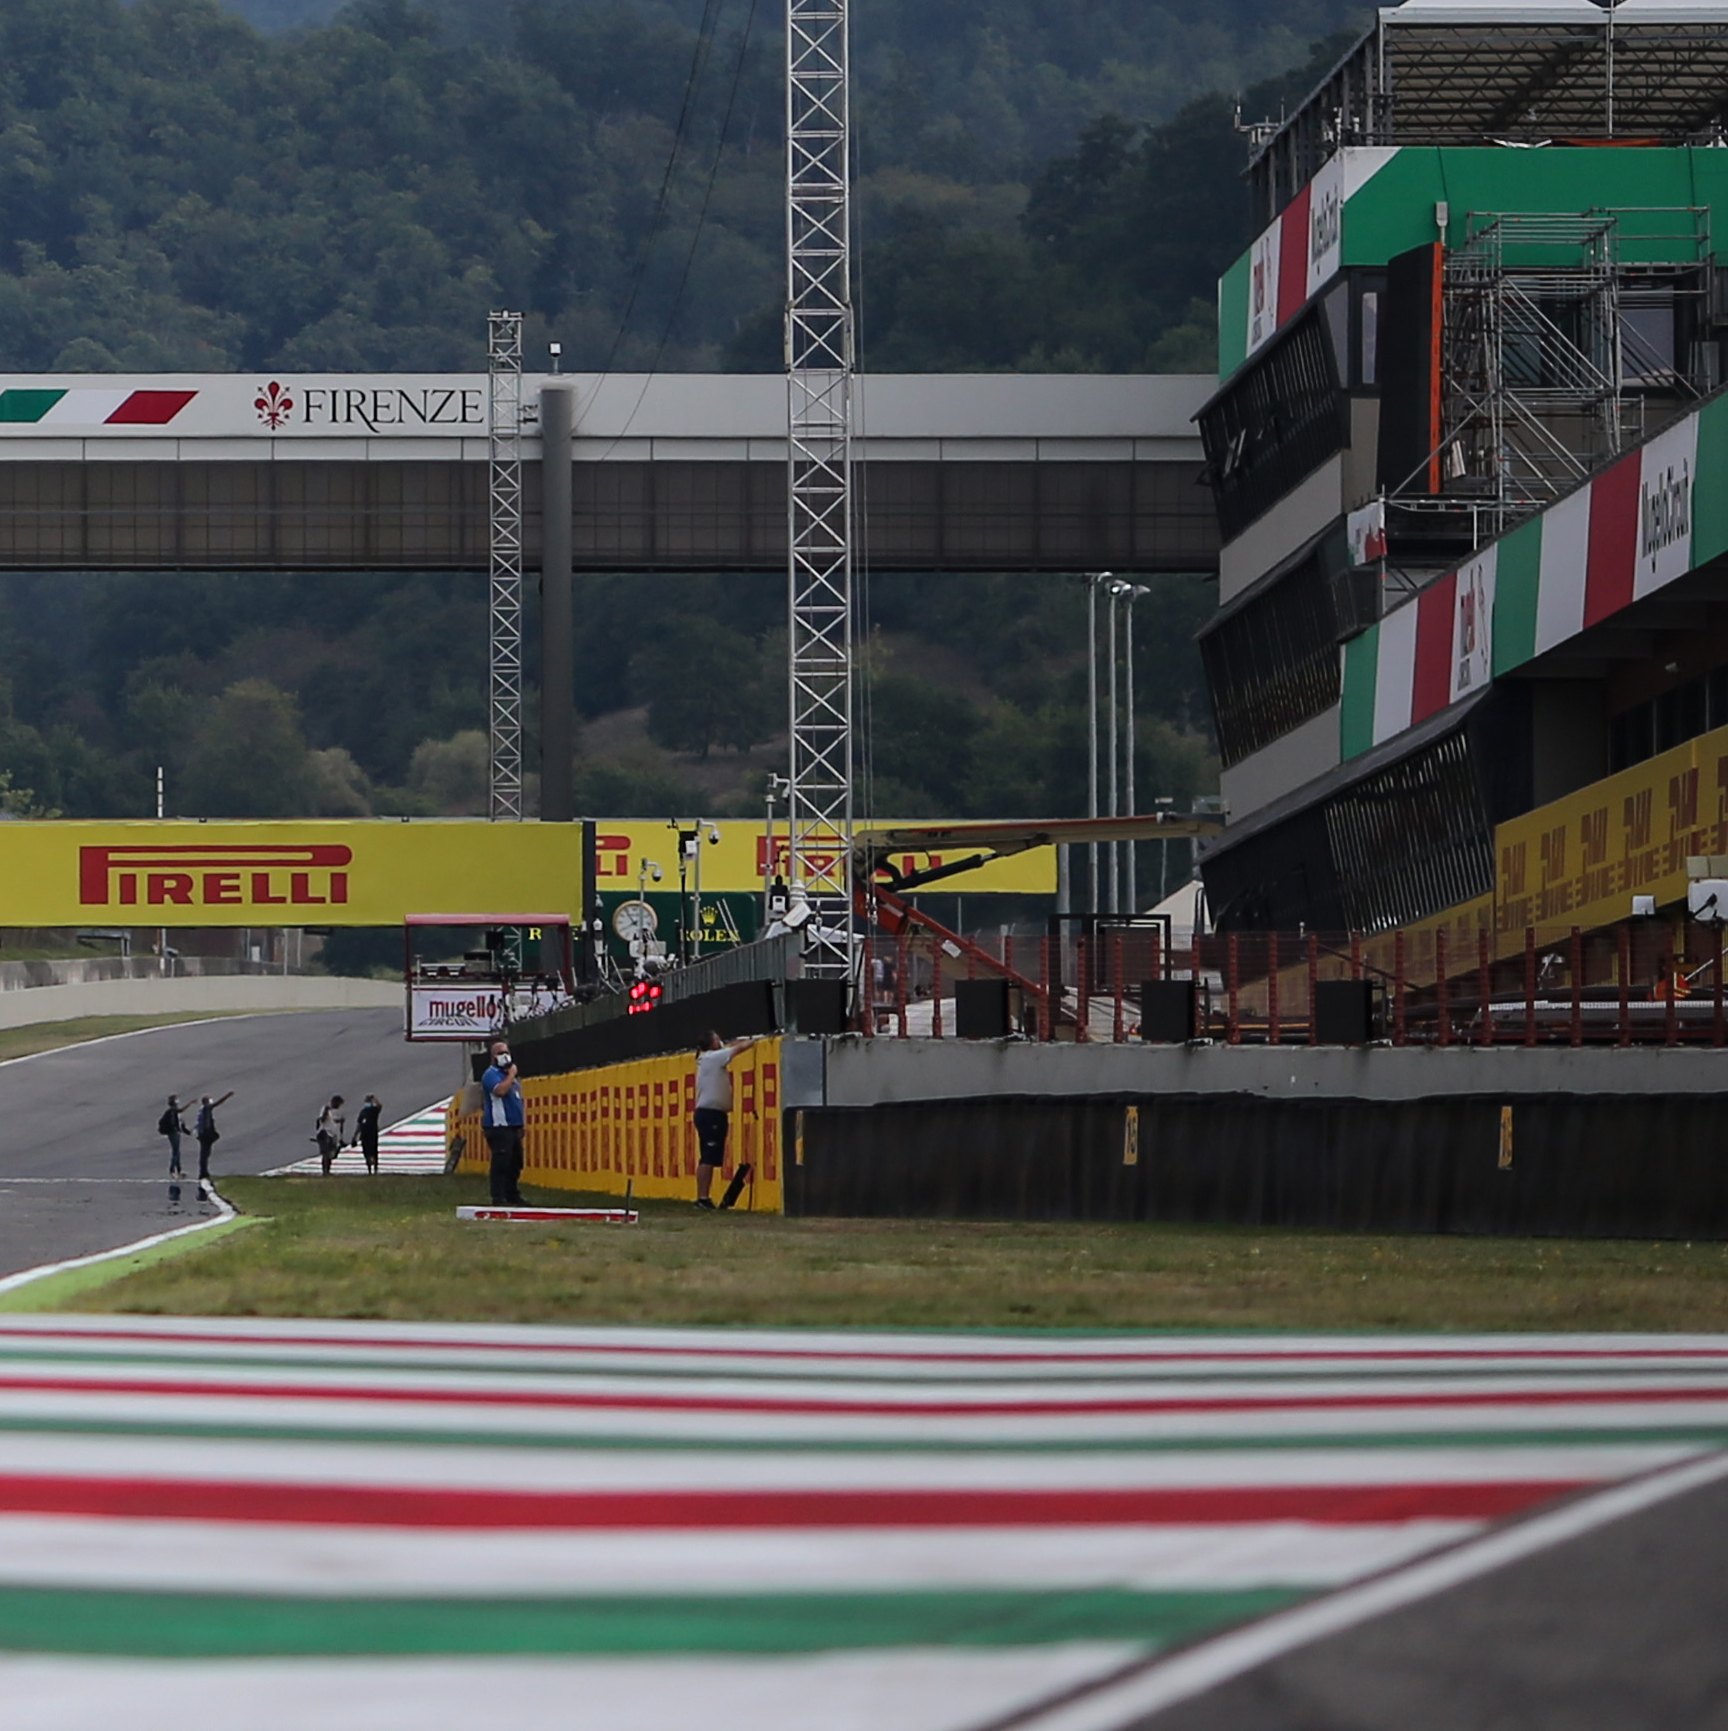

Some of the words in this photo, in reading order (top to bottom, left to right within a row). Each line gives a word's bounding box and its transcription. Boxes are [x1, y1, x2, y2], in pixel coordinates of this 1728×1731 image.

[303, 389, 484, 433] FIRENZE
[80, 845, 352, 904] PIRELLI
[429, 996, 496, 1018] mugello
